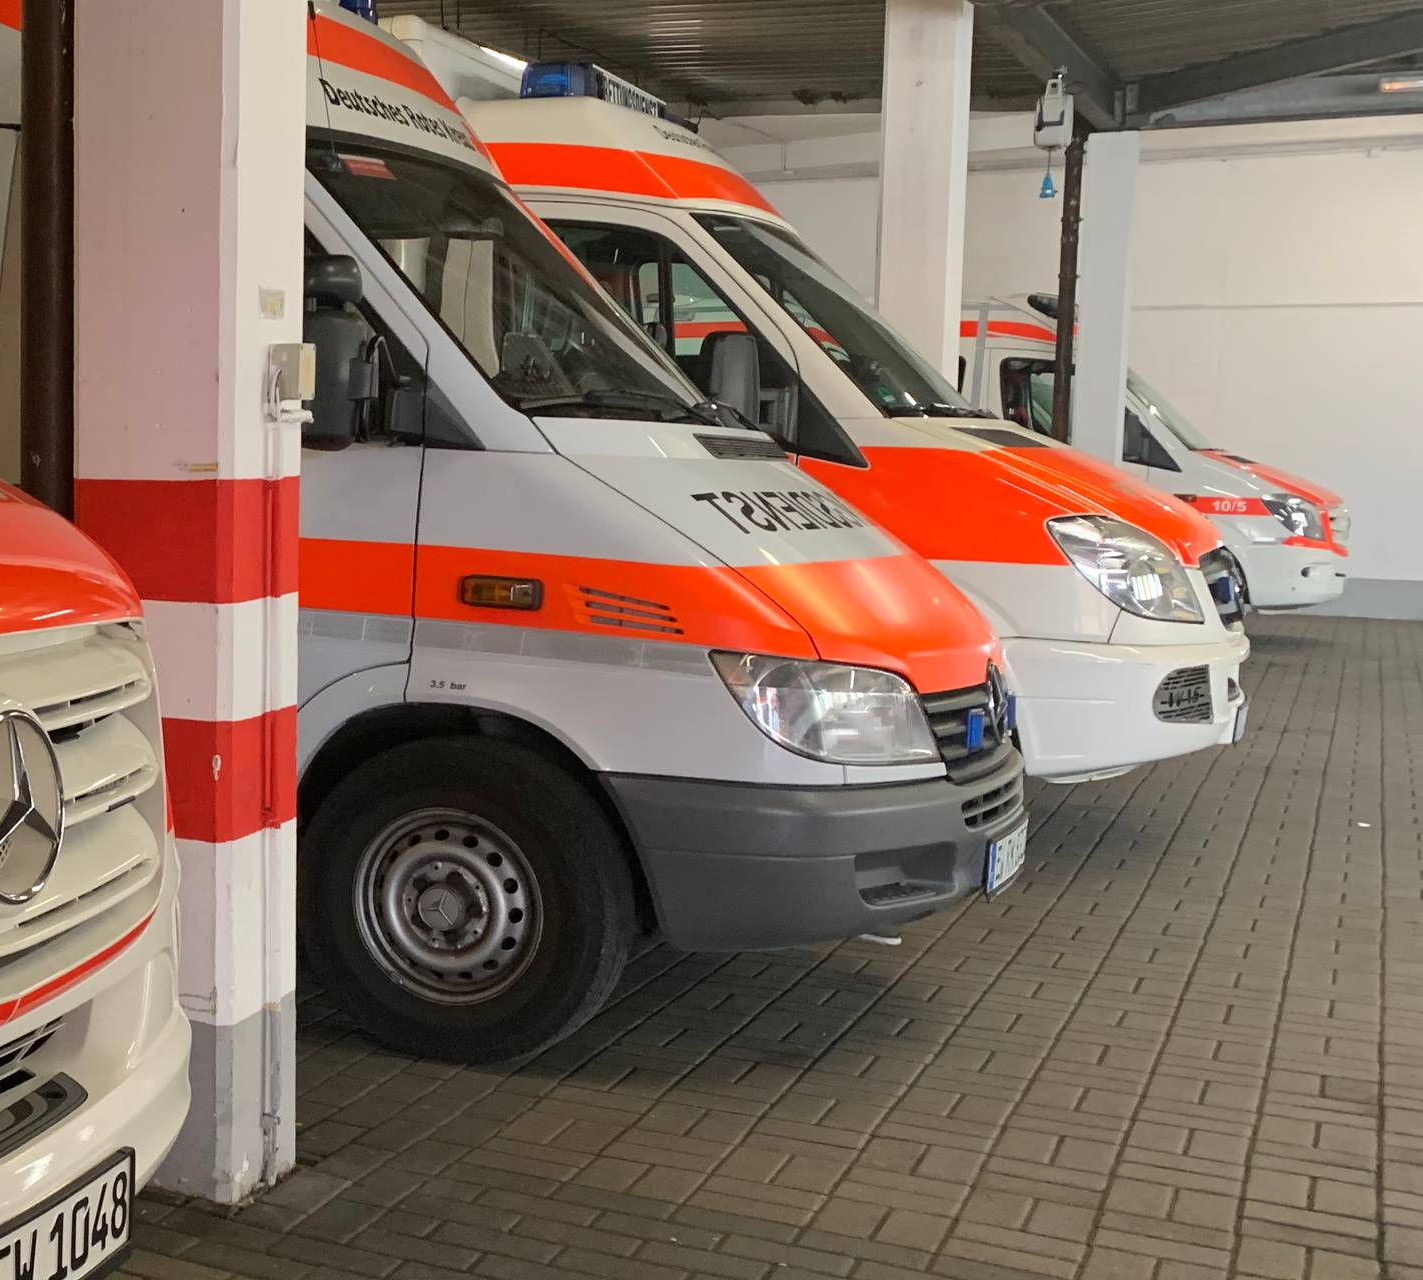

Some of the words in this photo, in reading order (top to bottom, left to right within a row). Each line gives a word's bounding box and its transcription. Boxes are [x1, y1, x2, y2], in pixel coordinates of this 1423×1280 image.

[318, 78, 410, 126] Deutsches
[1212, 500, 1247, 513] 10/5
[449, 681, 467, 690] bar
[47, 1171, 128, 1280] 1048
